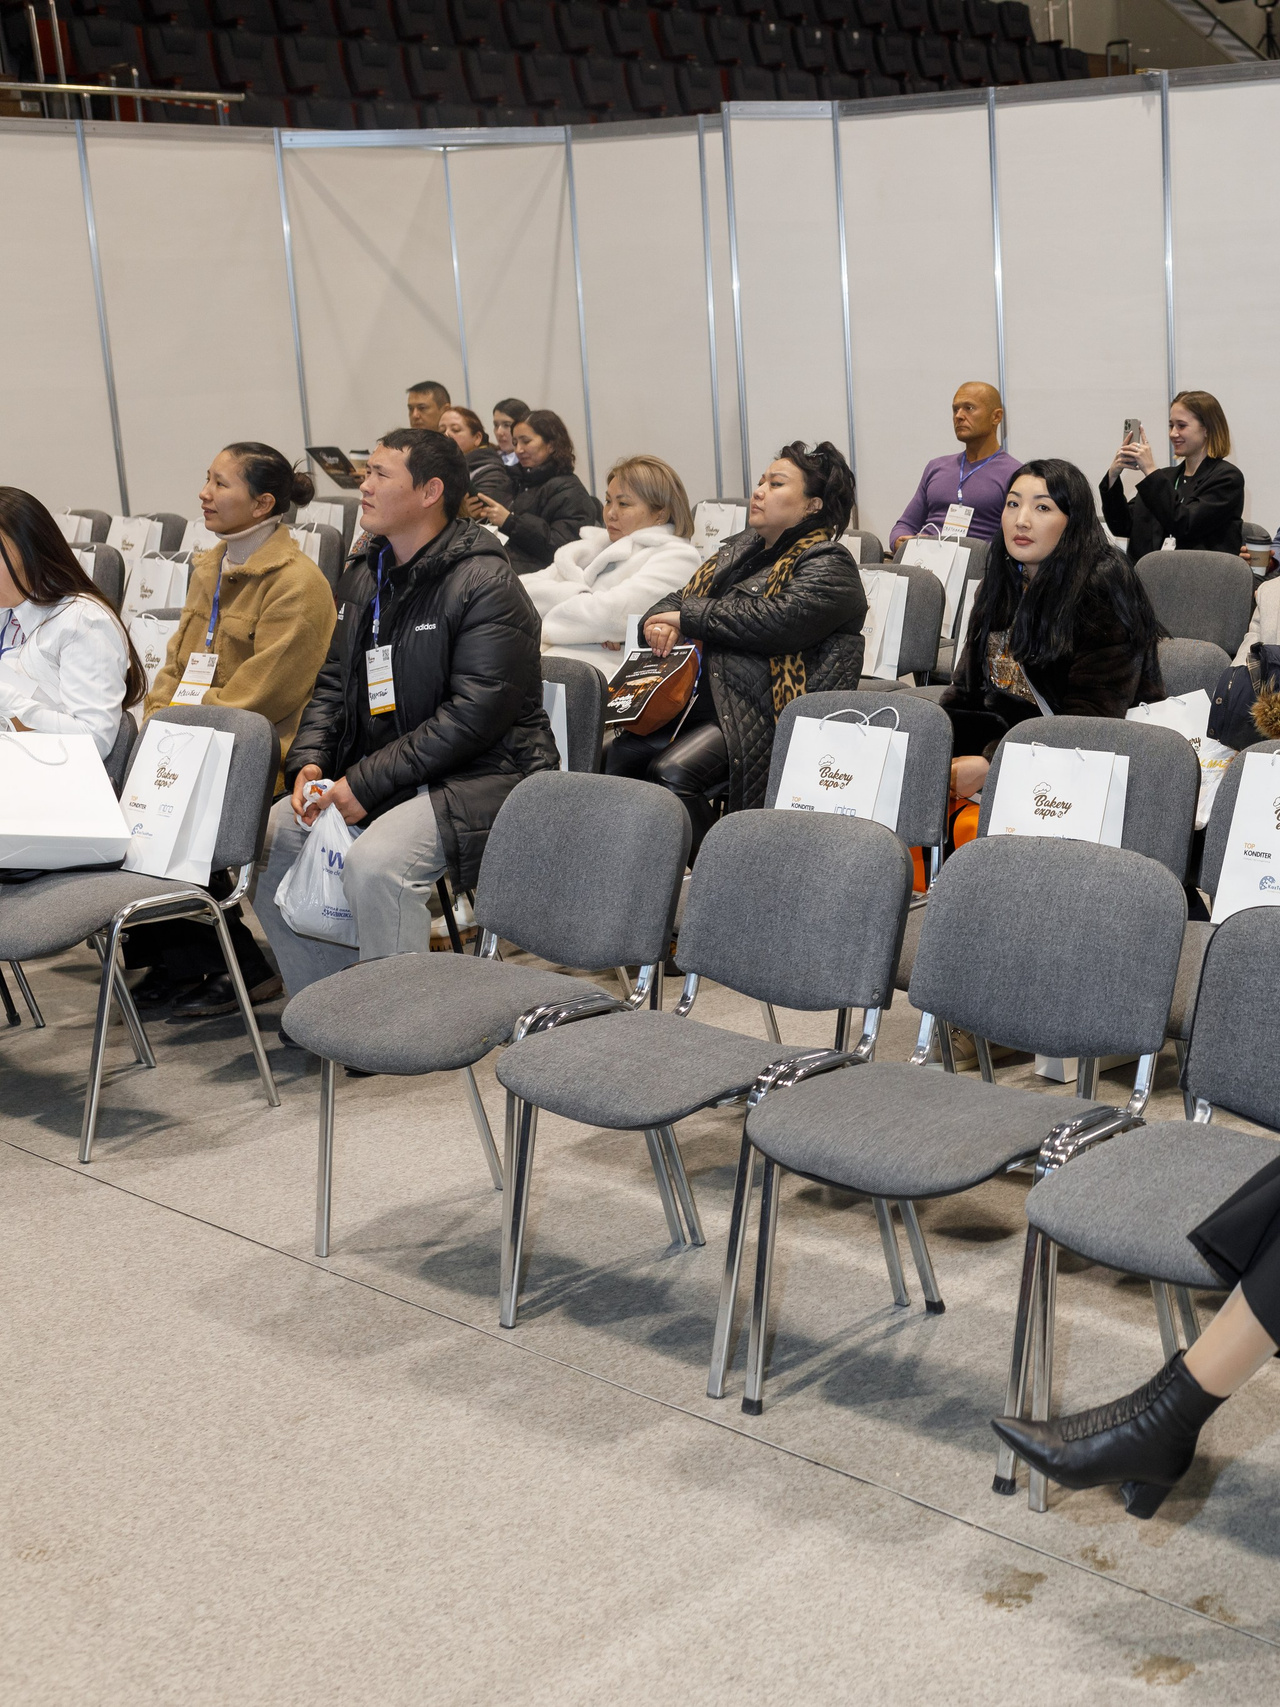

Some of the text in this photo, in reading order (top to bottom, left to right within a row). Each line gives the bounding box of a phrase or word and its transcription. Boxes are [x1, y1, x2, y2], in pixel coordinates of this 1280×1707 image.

[414, 623, 437, 632] adidas
[819, 766, 853, 785] Bakery
[819, 779, 839, 791] expo
[791, 802, 815, 812] KONDITER
[834, 803, 857, 817] intro
[1034, 794, 1072, 814] Bakery
[1034, 807, 1057, 819] expo
[1243, 849, 1272, 860] KONDITER
